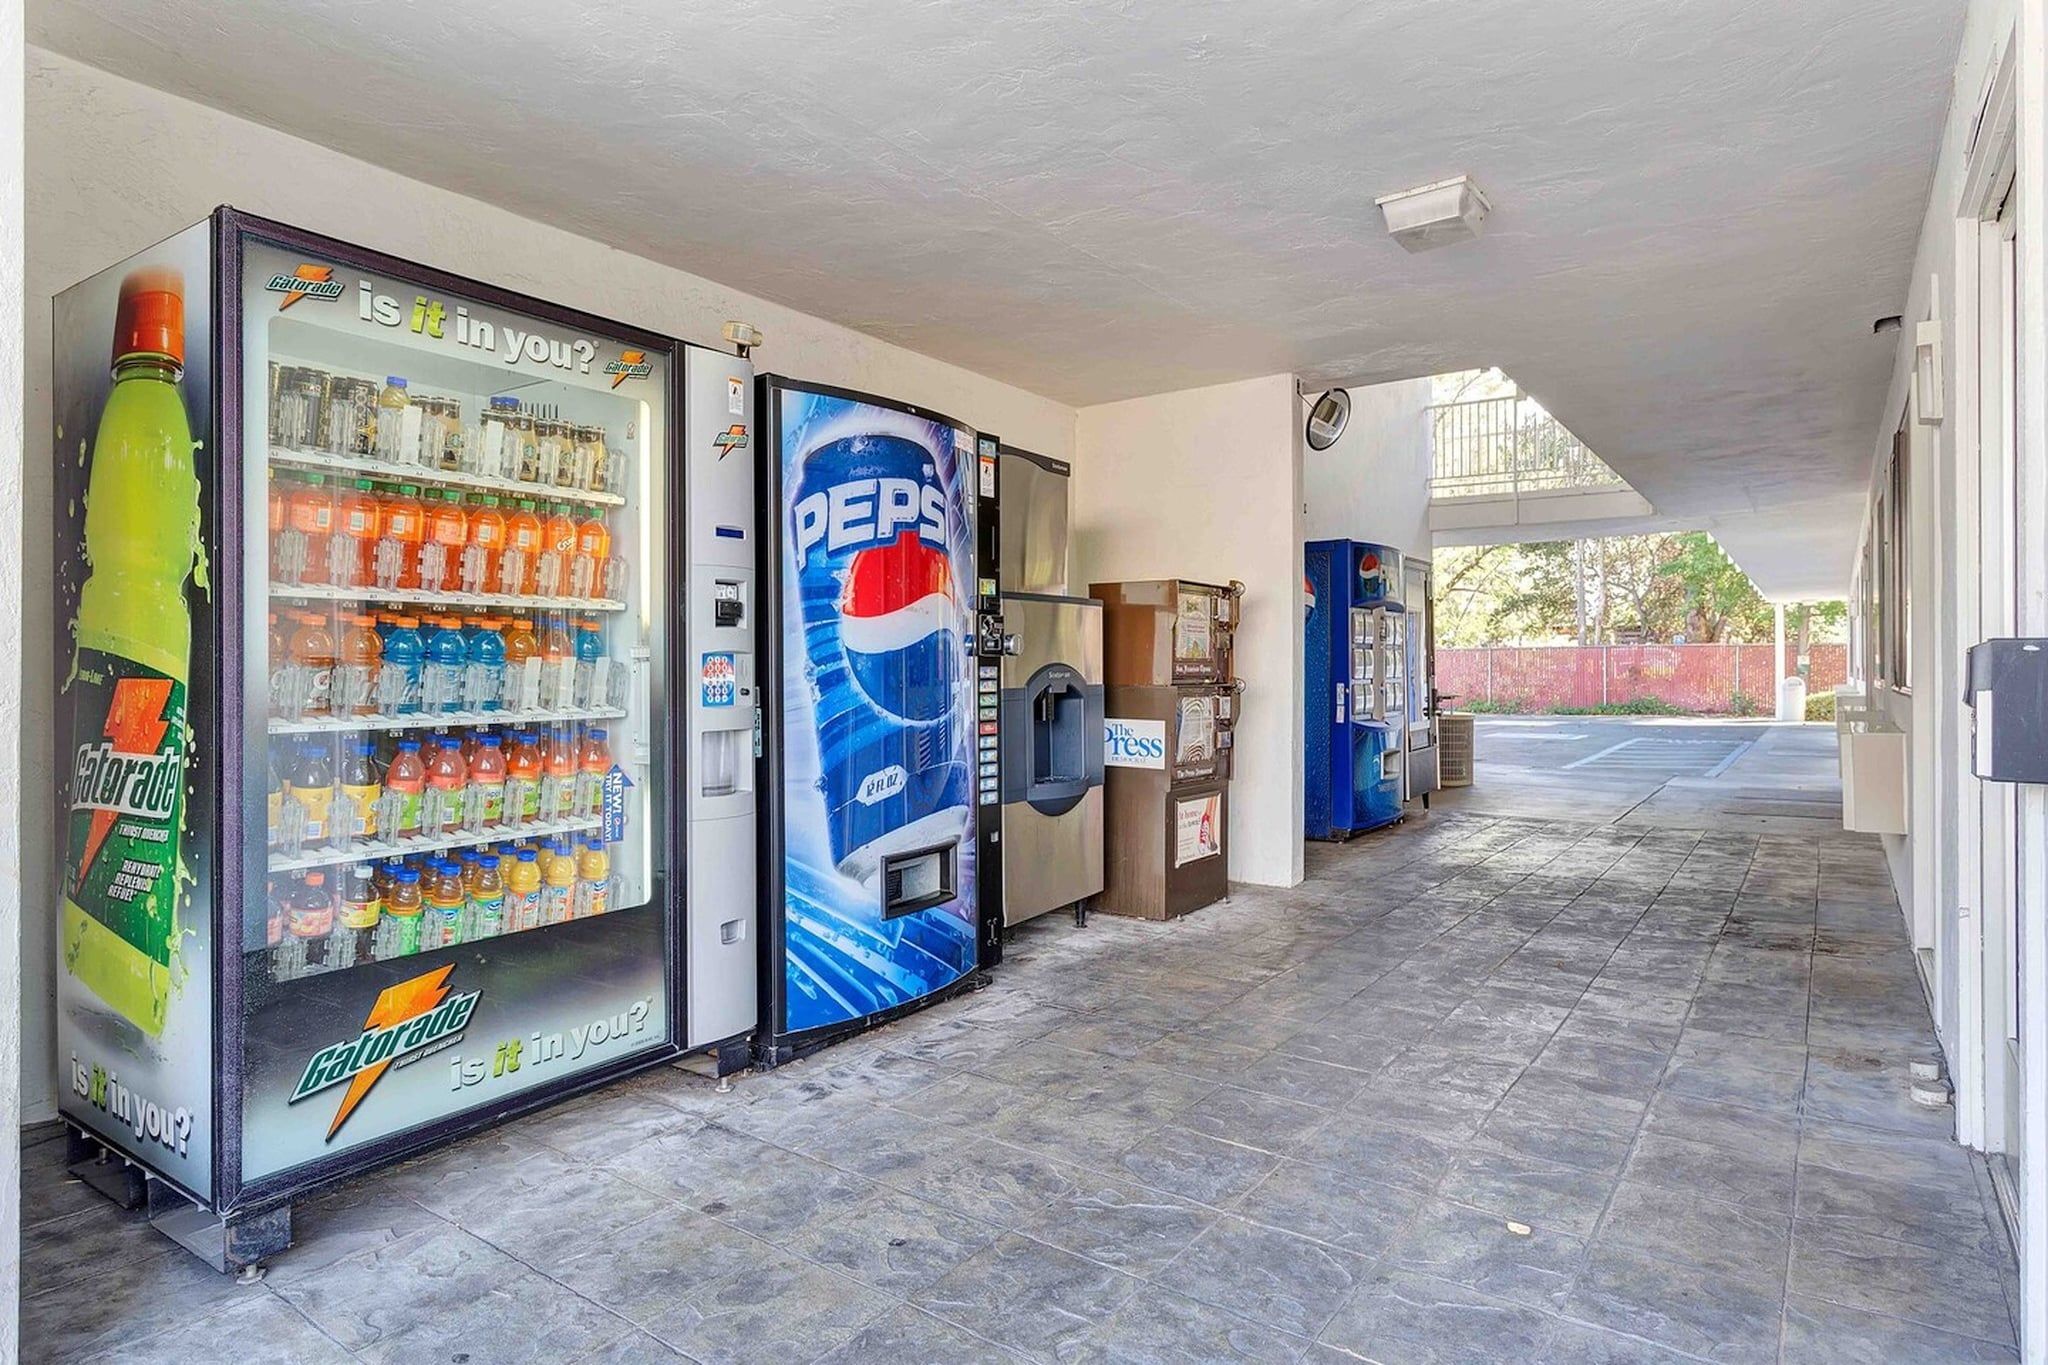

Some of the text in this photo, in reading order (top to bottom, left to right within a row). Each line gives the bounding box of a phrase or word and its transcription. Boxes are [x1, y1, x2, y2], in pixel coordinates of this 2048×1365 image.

[267, 274, 344, 297] Gatorade
[359, 280, 595, 373] is it in you?
[603, 360, 652, 381] Gatorade
[795, 478, 949, 572] PEPS
[1112, 723, 1134, 736] The
[73, 748, 178, 812] Gatorade
[605, 794, 612, 803] IT
[613, 772, 622, 813] NEW!
[296, 992, 479, 1095] Gatorade
[451, 999, 649, 1091] is it in you?
[72, 1050, 191, 1158] is it in you?
